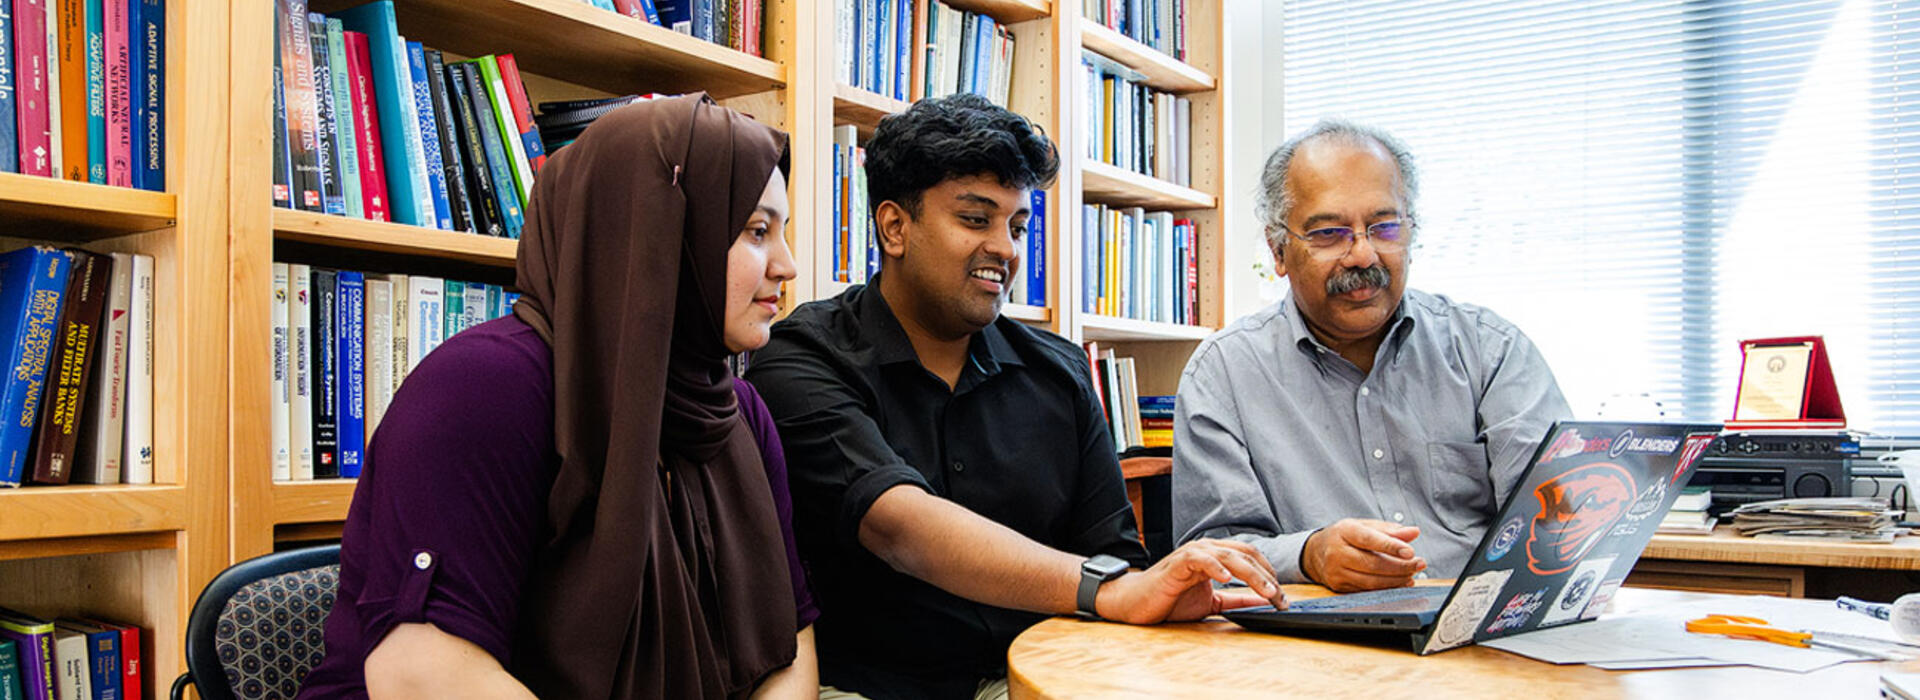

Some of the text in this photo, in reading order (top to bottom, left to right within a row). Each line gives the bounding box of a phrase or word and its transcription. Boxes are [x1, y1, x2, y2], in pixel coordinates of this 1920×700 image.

[290, 1, 308, 55] Signals
[90, 32, 100, 117] ADAPTIVE FILTERS
[110, 64, 119, 124] NETWORKS
[119, 44, 129, 147] ARTIFICIAL NEURAL
[148, 22, 159, 170] ADAPTIVE SIGNAL PROCESSING
[295, 59, 311, 87] and
[313, 66, 326, 116] SYSTEMS
[321, 66, 336, 135] CONCEPTS IN
[299, 90, 316, 151] Systems
[318, 141, 332, 185] SIGNALS
[17, 289, 47, 381] WITH APPLICATIONS
[113, 329, 123, 346] Fast
[429, 301, 439, 341] Digital
[19, 290, 60, 428] DIGITAL SPECTRAL ANALYSIS
[53, 321, 78, 425] AND FILTER BANKS
[63, 323, 90, 435] MULTIRATE SYSTEMS
[112, 347, 122, 375] Fourier
[325, 291, 333, 417] Communication Systems
[352, 288, 362, 419] COMMUNICATION SYSTEMS
[1629, 438, 1679, 452] BLENDERS
[41, 636, 50, 660] Digital
